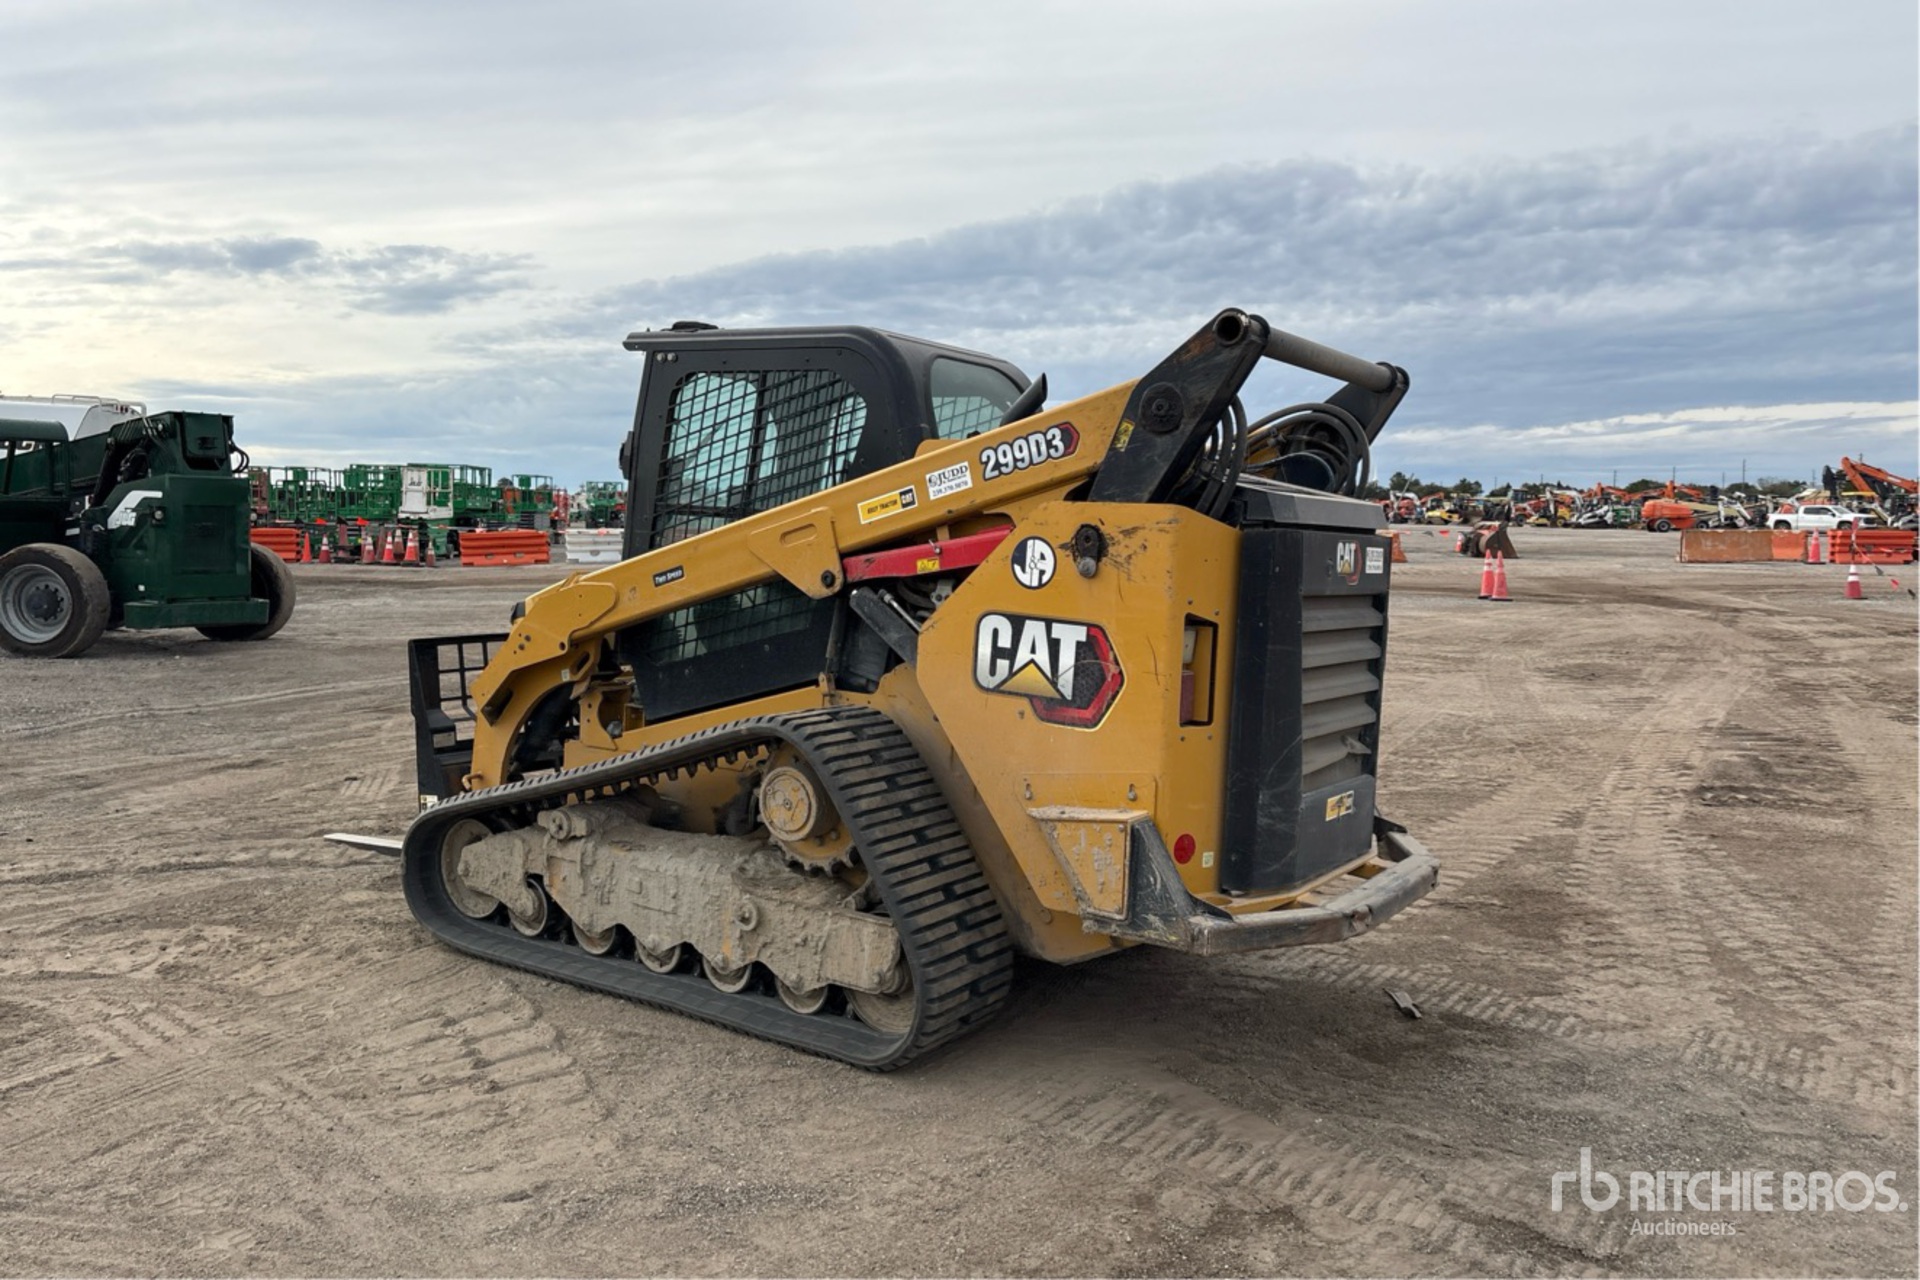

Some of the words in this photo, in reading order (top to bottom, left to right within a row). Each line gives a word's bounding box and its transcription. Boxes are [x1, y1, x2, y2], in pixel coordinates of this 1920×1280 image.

[980, 427, 1065, 480] 299D3
[937, 464, 969, 486] JUDD
[1336, 542, 1356, 573] CAT
[976, 613, 1088, 701] CAT
